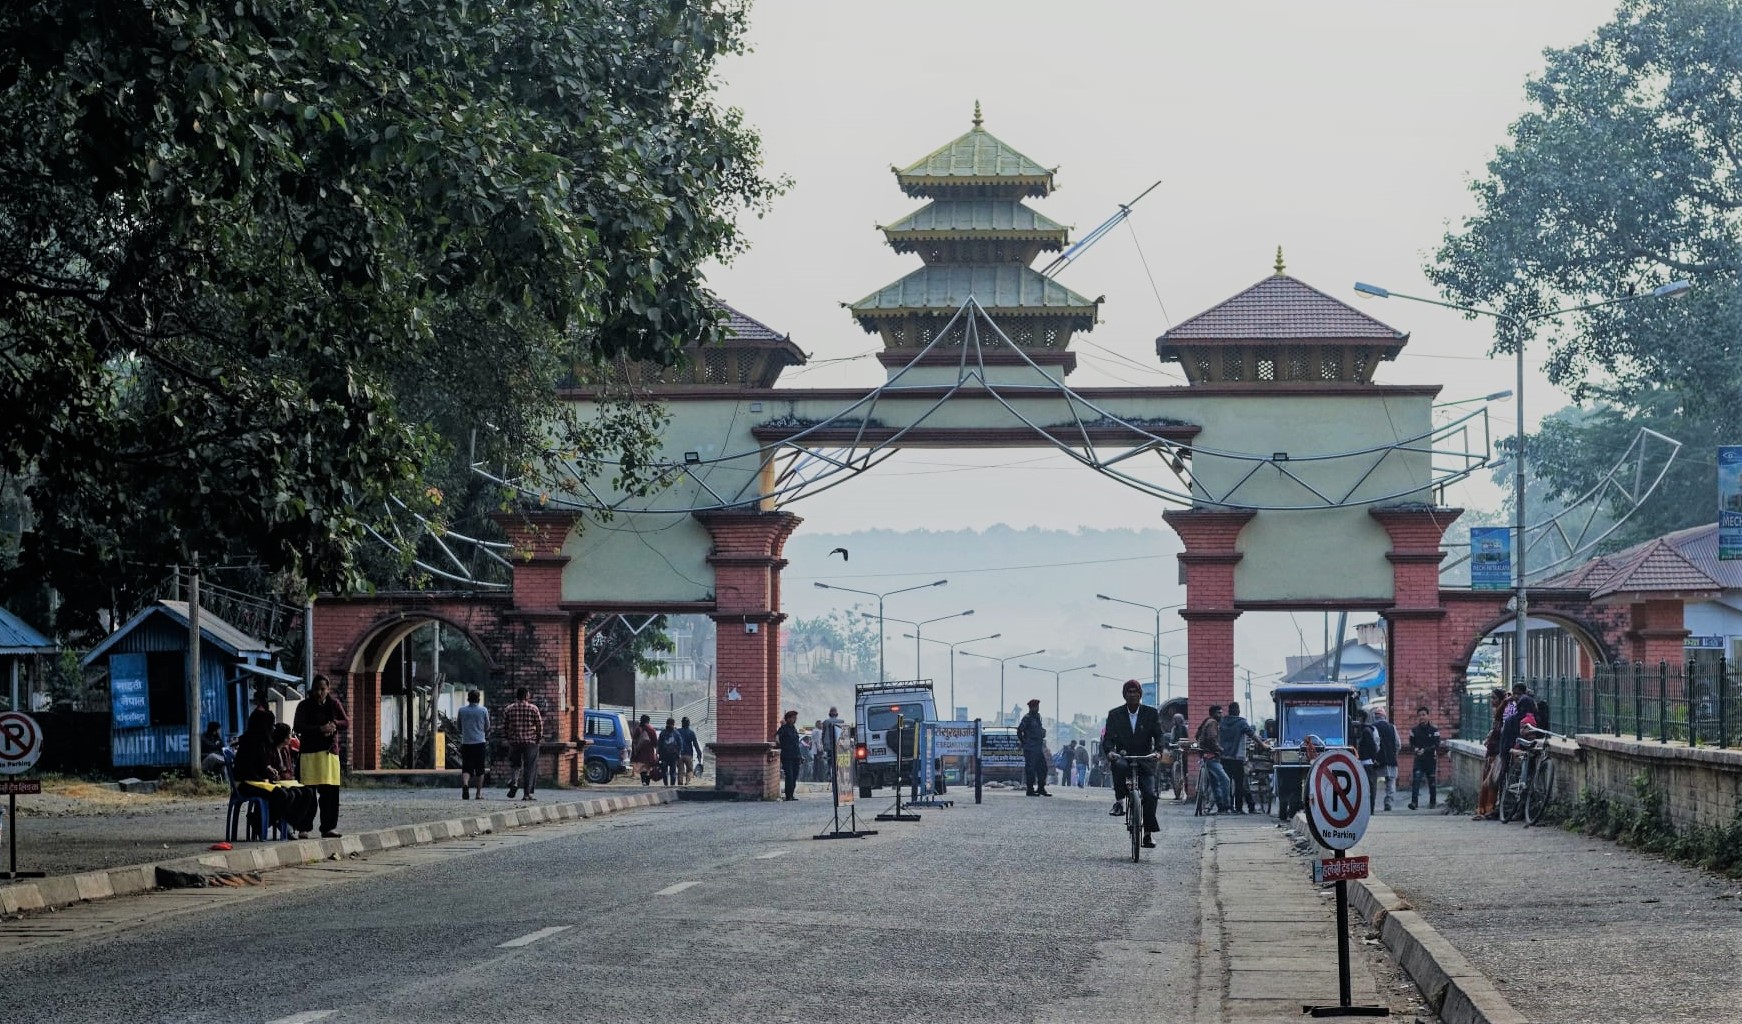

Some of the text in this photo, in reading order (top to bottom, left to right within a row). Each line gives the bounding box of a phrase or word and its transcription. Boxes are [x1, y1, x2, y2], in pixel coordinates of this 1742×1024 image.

[113, 736, 155, 754] MAITI
[1322, 829, 1356, 841] No Parking
